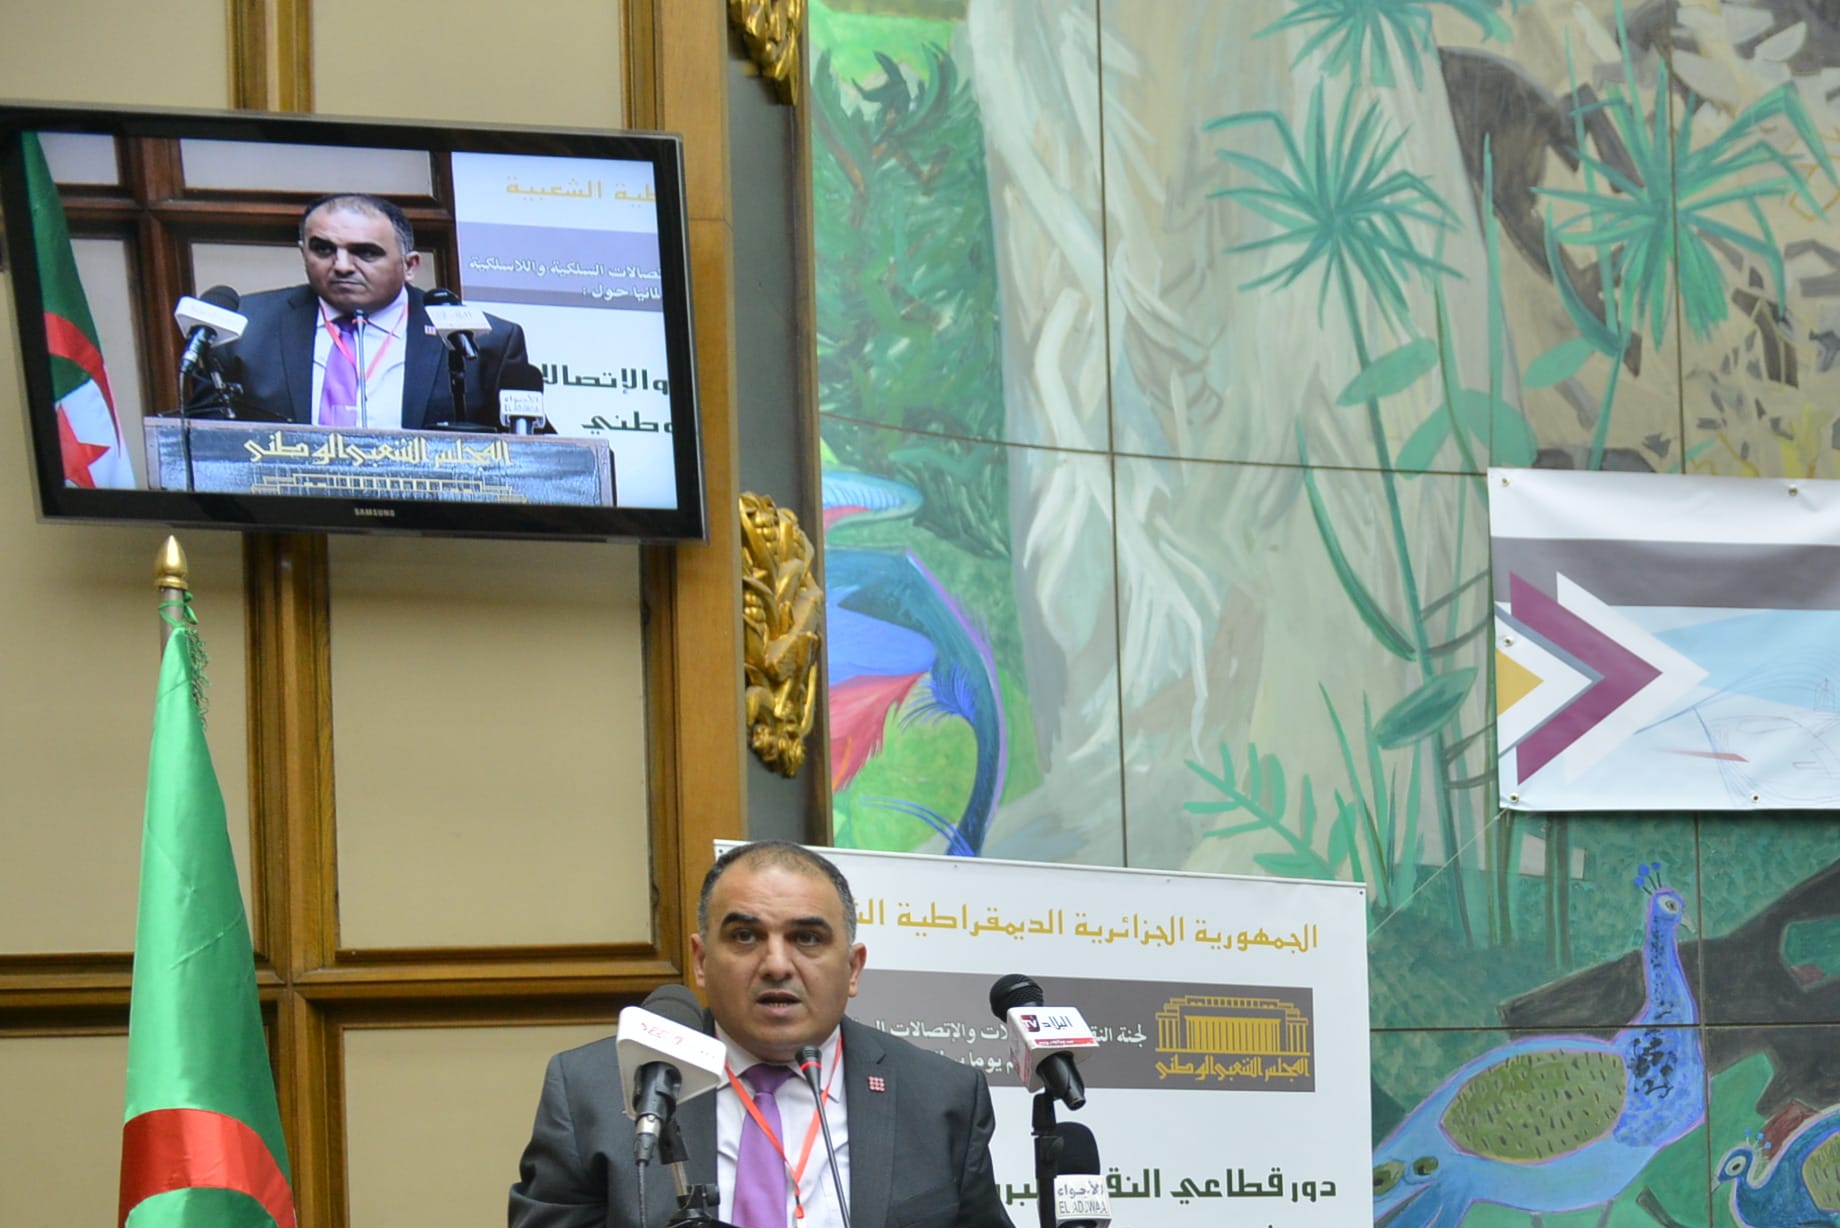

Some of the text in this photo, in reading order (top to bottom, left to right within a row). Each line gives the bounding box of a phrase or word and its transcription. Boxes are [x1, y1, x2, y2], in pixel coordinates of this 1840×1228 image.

[506, 175, 603, 201] الشعبية
[549, 256, 604, 277] السلكية
[607, 260, 662, 281] صالات
[591, 283, 628, 302] حول
[542, 363, 669, 395] والإتصالا
[582, 411, 672, 435] وطني
[354, 507, 396, 518] SAMSUNG
[897, 901, 1064, 940] الديمقراطية
[1073, 912, 1186, 946] الجزائرية
[1194, 918, 1319, 955] الجمهورية
[1119, 1024, 1147, 1048] لجنة
[1155, 1053, 1217, 1081] الوطني
[1106, 1166, 1337, 1205] دور قطاعي النق
[1059, 1200, 1071, 1214] EL
